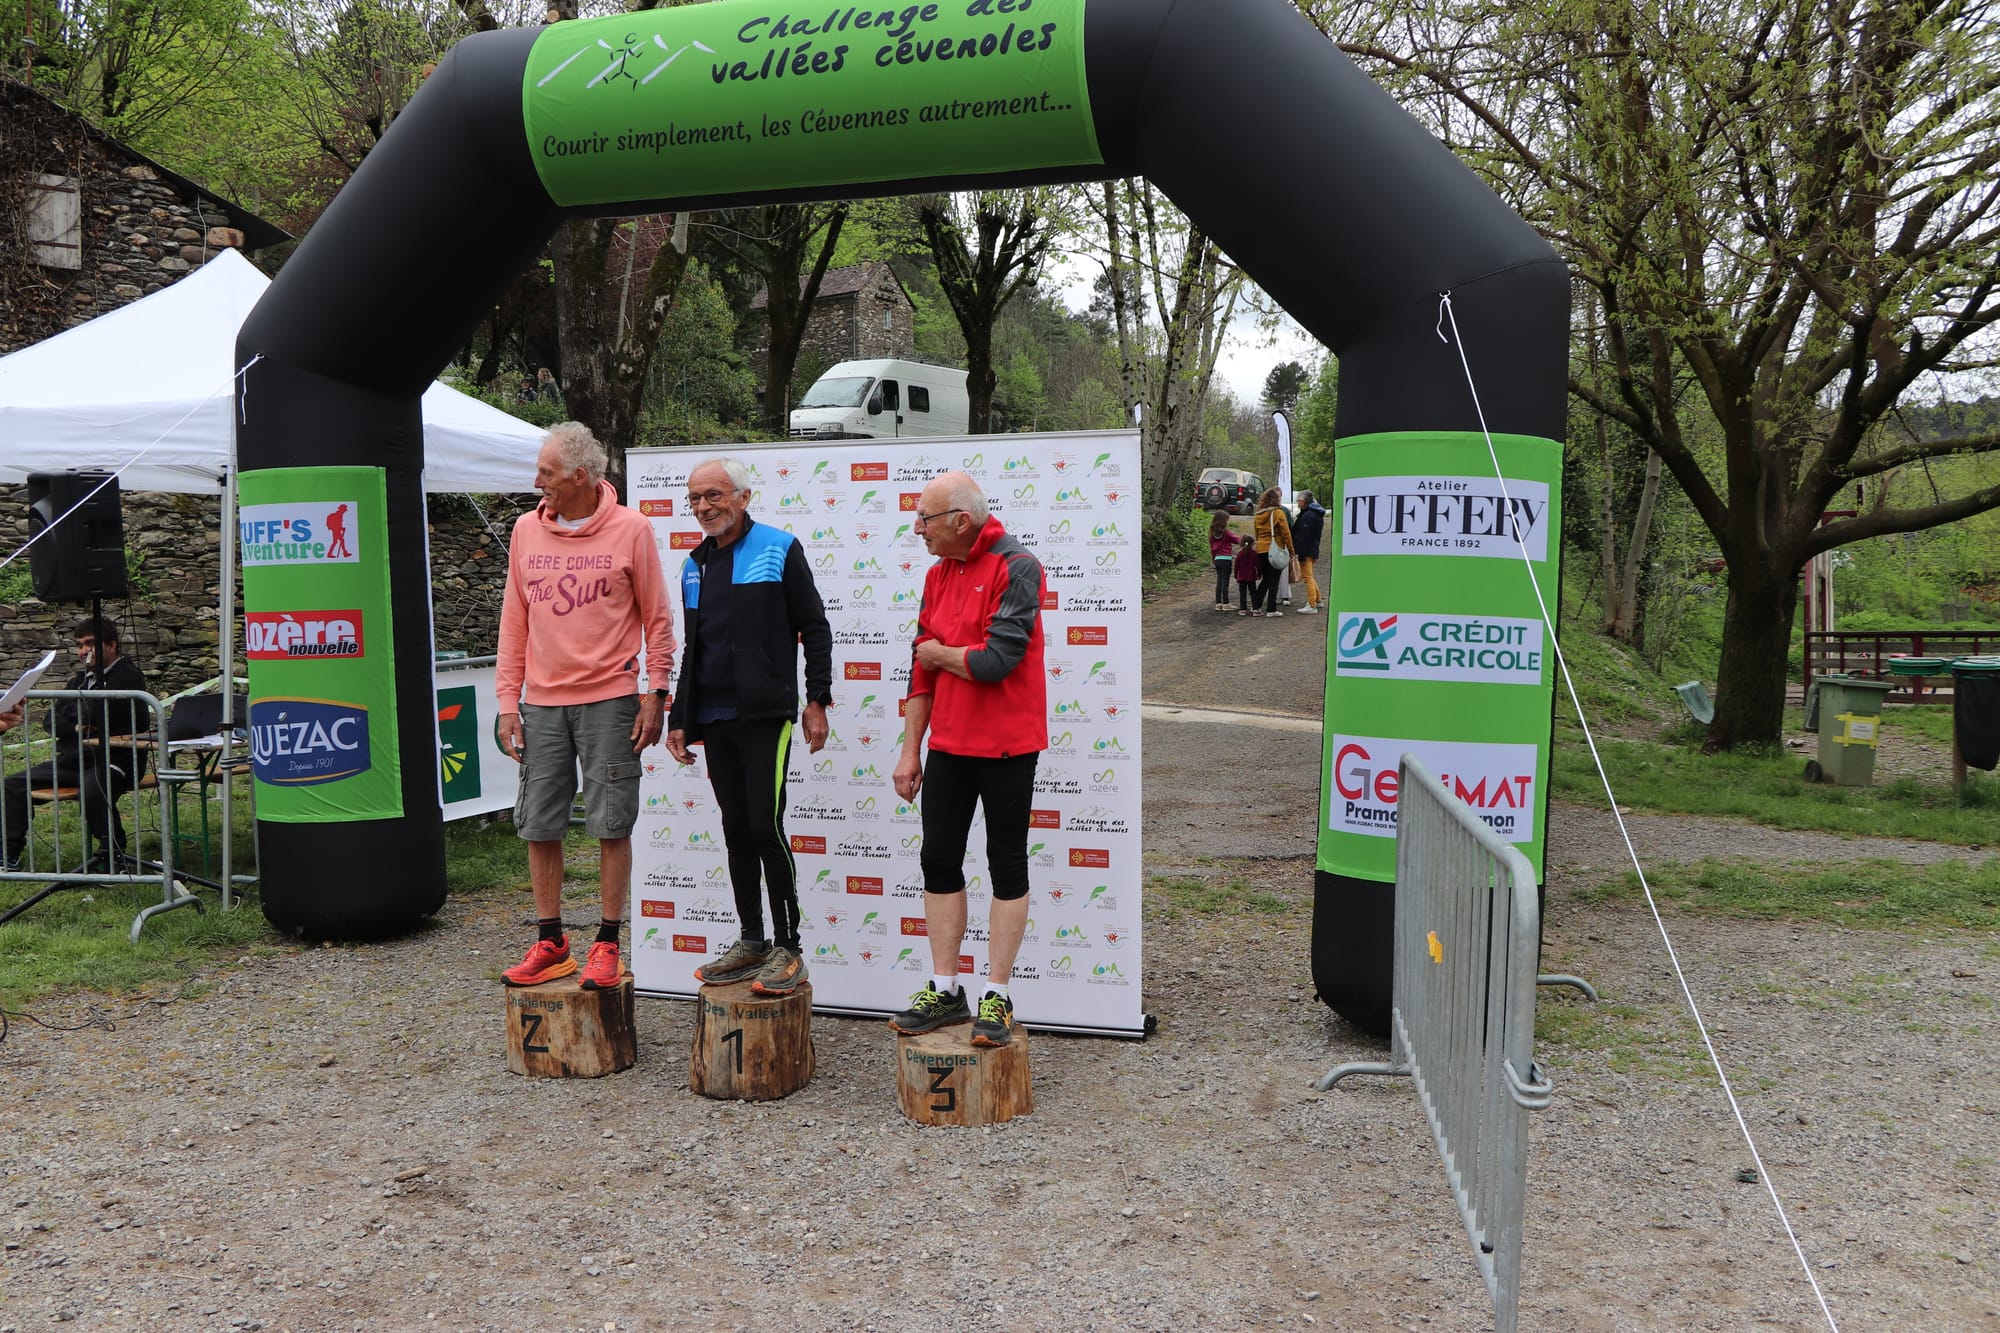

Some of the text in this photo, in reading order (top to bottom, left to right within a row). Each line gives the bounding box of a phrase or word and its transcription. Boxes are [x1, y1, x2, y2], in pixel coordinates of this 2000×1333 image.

[737, 4, 938, 43] Challenge
[712, 22, 1056, 84] vallées cévenoles
[544, 91, 1072, 157] Courir simplement, les Cévennes autrement...
[1417, 479, 1468, 492] Atelier
[1345, 494, 1547, 544] TUFFERY
[1401, 537, 1481, 549] FRANCE 1892
[528, 554, 613, 570] HERE COMES
[527, 573, 612, 616] The Sun
[288, 640, 359, 656] nouvelle
[1419, 620, 1528, 646] CRÉDIT
[1397, 645, 1541, 671] AGRICOLE
[251, 712, 359, 766] QUÉZAC
[315, 757, 334, 769] 1901
[721, 1029, 743, 1074] 1
[905, 1046, 977, 1066] Cévenoles
[928, 1066, 956, 1111] 3
